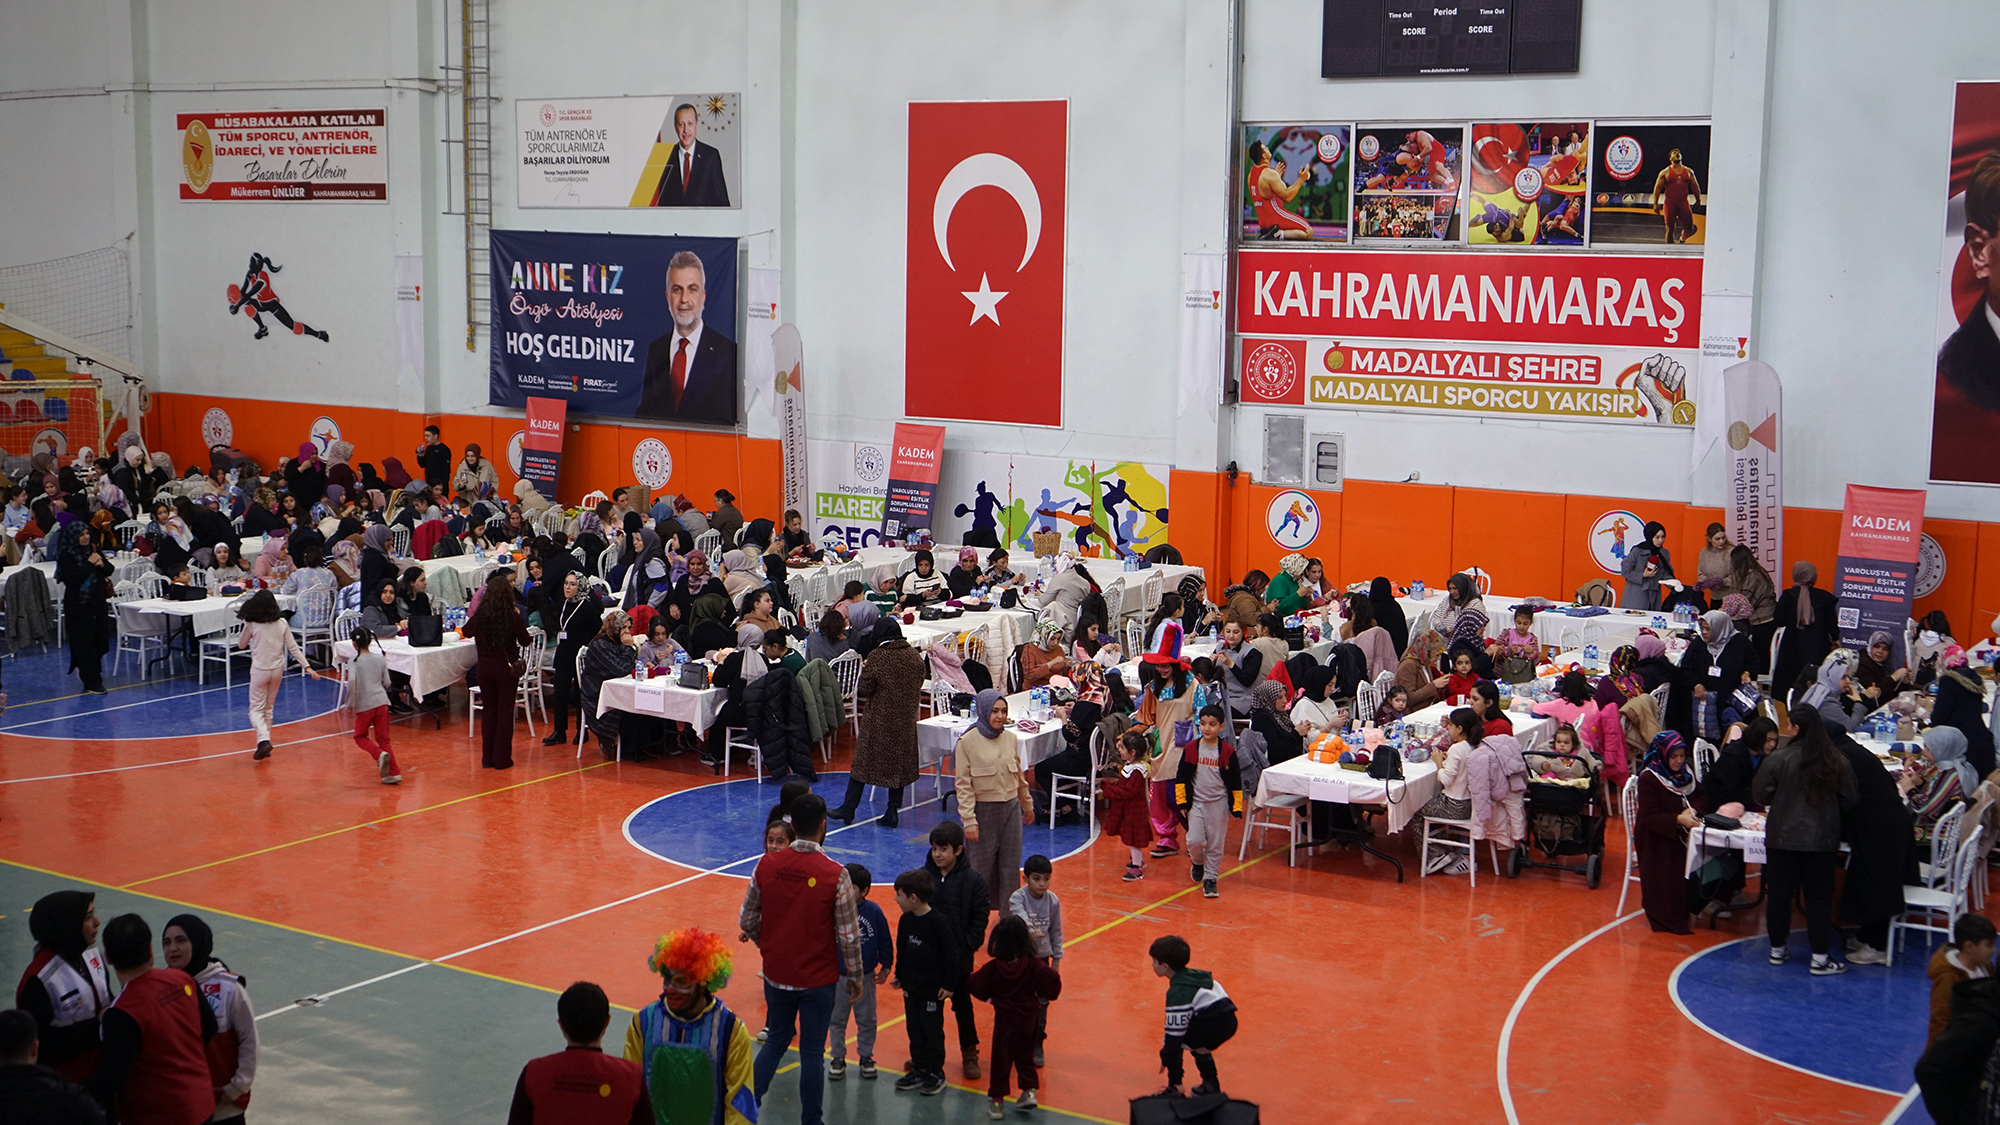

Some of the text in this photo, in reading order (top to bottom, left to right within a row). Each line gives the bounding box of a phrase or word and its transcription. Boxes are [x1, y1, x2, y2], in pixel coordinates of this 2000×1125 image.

[1433, 8, 1458, 16] Period
[1402, 27, 1427, 36] SCORE
[1468, 25, 1493, 34] SCORE
[214, 114, 376, 129] MÜSABAKALARA KATILAN
[218, 128, 373, 143] TÜM SPORCU, ANTRENÖR,
[525, 128, 607, 141] TÜM ANTRENÖR VE
[215, 143, 378, 158] İDARECİ, VE YÖNETİCİLERE
[527, 141, 605, 154] SPORCULARIMIZA
[523, 154, 610, 167] BAŞARILAR DİLİYORUM
[299, 157, 347, 180] Dilerim
[230, 185, 306, 198] Mükerrem ÜNLÜER
[313, 189, 359, 198] KAHRAMANMARAŞ
[510, 261, 623, 294] ANNE KIZ
[555, 297, 623, 327] Atölyesi
[1253, 270, 1686, 343] KAHRAMANMARAŞ
[506, 331, 544, 363] HOŞ
[1351, 350, 1597, 382] MADALYALI ŞEHRE
[518, 374, 544, 384] KADEM
[1314, 380, 1635, 416] MADALYALI SPORCU YAKIŞIR
[530, 418, 560, 431] KADEM
[898, 446, 935, 460] KADEM
[838, 484, 888, 495] Hayalleri Bıra
[819, 496, 885, 519] HAREK
[1852, 515, 1911, 532] KADEM
[1850, 532, 1910, 543] KAHRAMANMARAŞ
[1844, 566, 1890, 577] VAROLUŞTA
[1841, 591, 1871, 600] ADALET
[1842, 583, 1905, 595] SORUMLULUKTA
[1165, 1013, 1190, 1027] ULES
